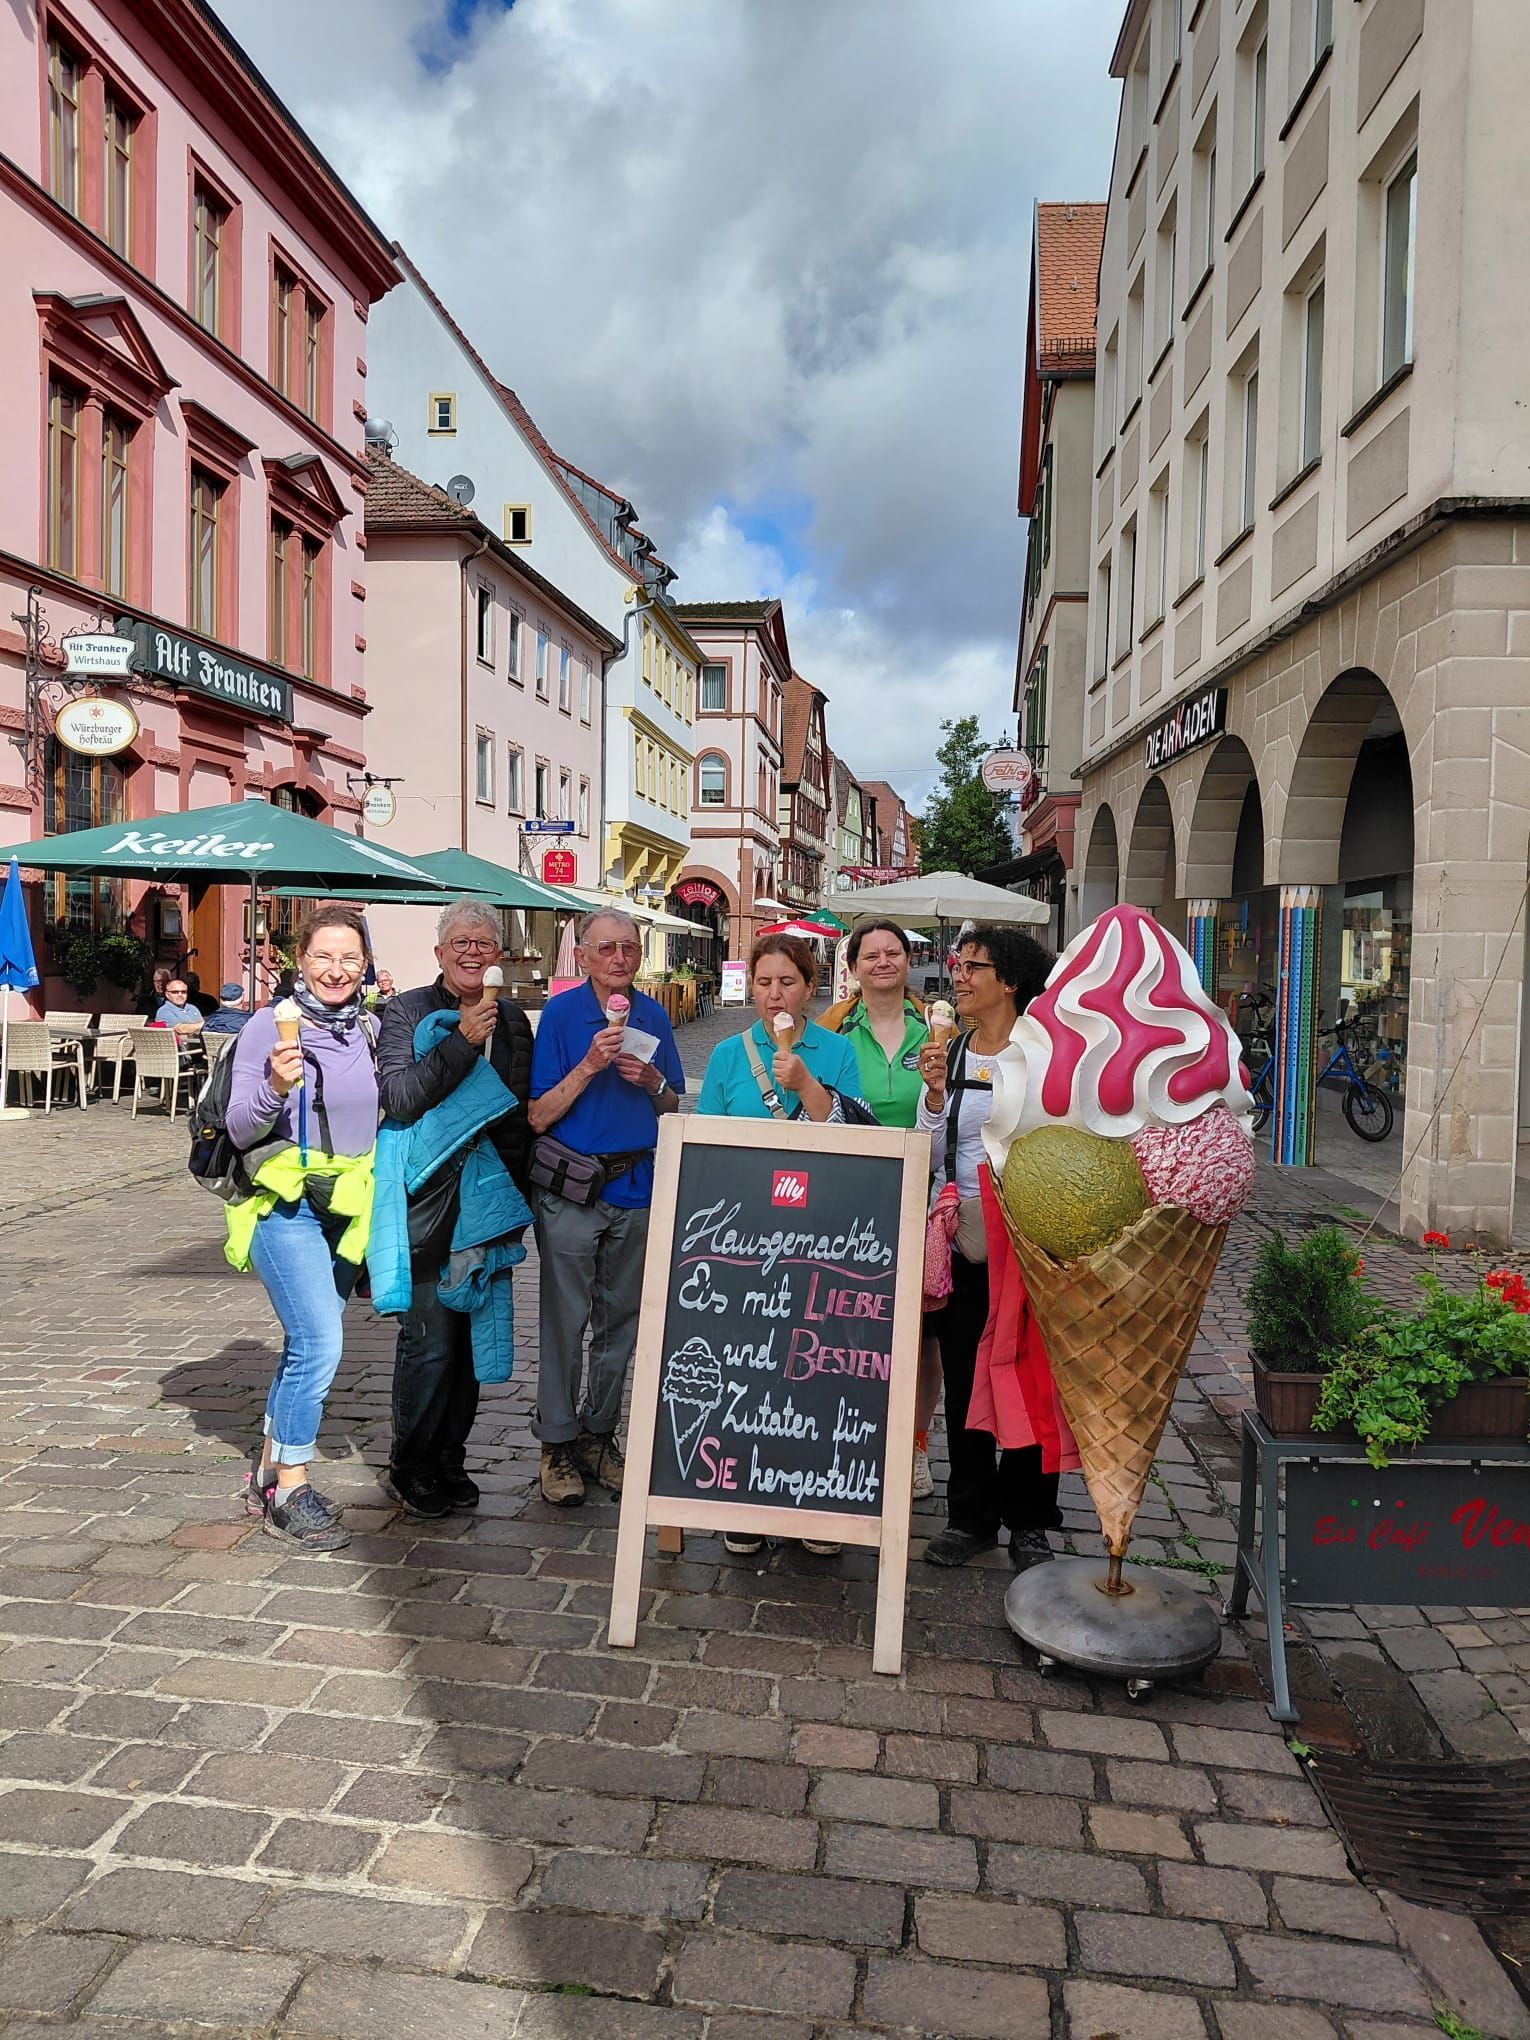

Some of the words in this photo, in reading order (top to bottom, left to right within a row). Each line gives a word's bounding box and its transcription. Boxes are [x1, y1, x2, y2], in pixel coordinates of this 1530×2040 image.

[69, 643, 84, 652] Alt
[85, 643, 128, 653] Franken
[74, 655, 121, 666] Wirtshaus
[155, 632, 191, 677] Alt
[198, 651, 282, 712] Franken
[71, 723, 122, 735] Würzburger
[79, 734, 113, 744] Hofbräu
[1145, 728, 1161, 769] DIE
[1160, 688, 1218, 761] ARKADEN
[101, 831, 276, 859] Keiler
[774, 1175, 805, 1202] illy
[681, 1198, 893, 1276] Hausgemachtes
[678, 1261, 729, 1315] Eis
[742, 1272, 792, 1319] mit
[803, 1271, 893, 1322] LIEBE
[722, 1328, 777, 1373] und
[784, 1327, 891, 1382] BESTEN
[721, 1380, 820, 1442] Zutaten
[832, 1396, 878, 1453] für
[695, 1436, 738, 1490] SIE
[748, 1443, 881, 1506] hergestellt
[1312, 1515, 1357, 1546] Eis
